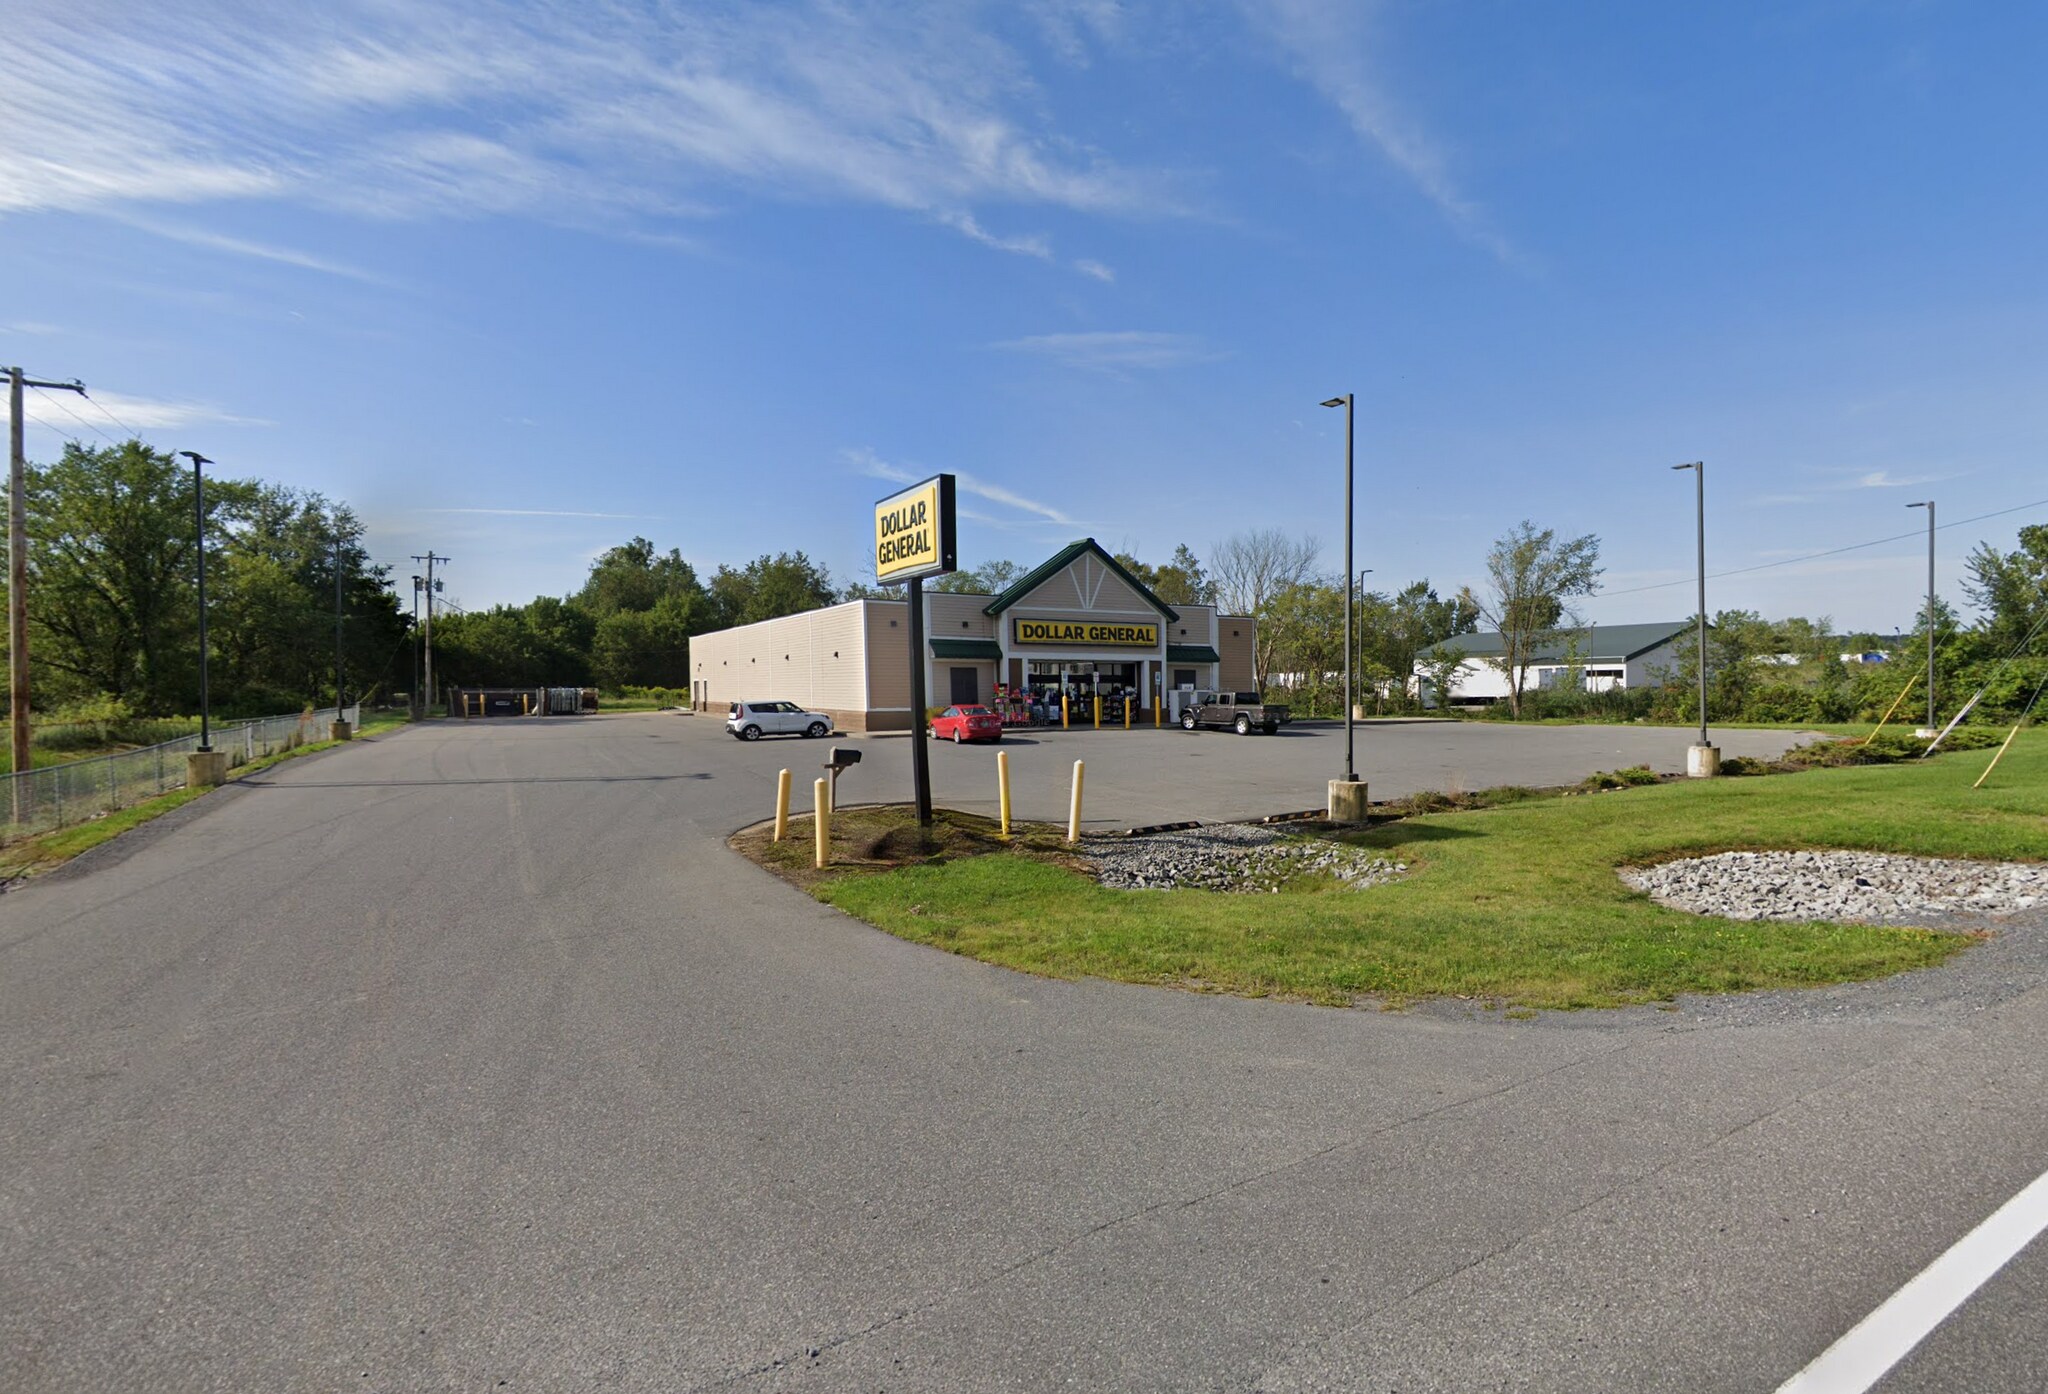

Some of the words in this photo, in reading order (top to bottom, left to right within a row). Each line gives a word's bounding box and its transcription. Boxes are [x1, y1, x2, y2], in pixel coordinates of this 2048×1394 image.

[881, 500, 927, 538] DOLLAR
[879, 529, 931, 565] GENERAL
[1022, 624, 1085, 640] DOLLAR
[1089, 626, 1154, 642] GENERAL
